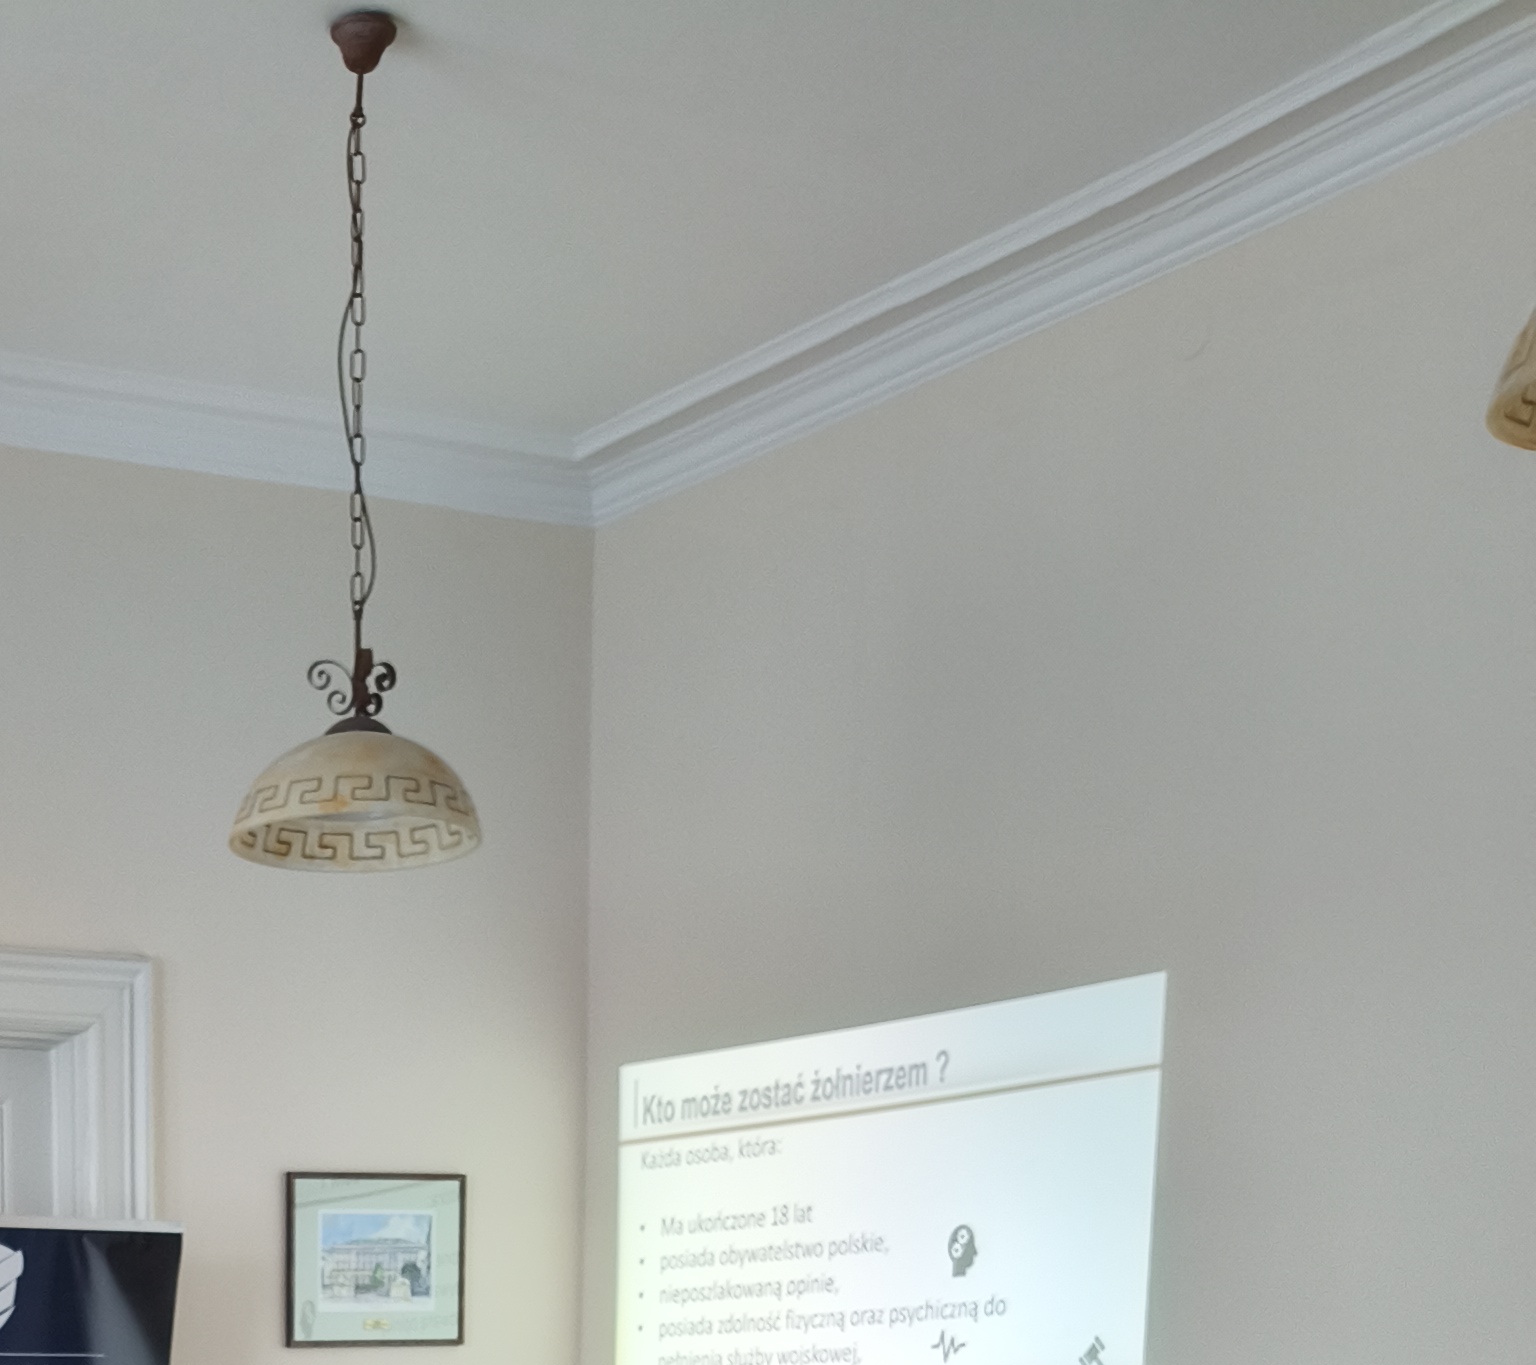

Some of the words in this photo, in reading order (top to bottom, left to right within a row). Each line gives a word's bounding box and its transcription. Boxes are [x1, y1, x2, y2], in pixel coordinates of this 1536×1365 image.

[642, 1094, 675, 1125] Kto
[681, 1085, 732, 1121] może
[738, 1072, 805, 1113] zostać
[810, 1062, 928, 1103] żołnierzem
[935, 1050, 950, 1083] ?
[661, 1217, 684, 1236] Ma
[688, 1210, 766, 1234] ukończone
[771, 1204, 789, 1226] 18
[793, 1203, 814, 1224] lat
[660, 1248, 715, 1273] posiada
[719, 1240, 824, 1267] obywatelstwo
[659, 1316, 713, 1341] posiada
[717, 1311, 782, 1335] zdolność
[786, 1308, 845, 1332] fizyczną
[850, 1308, 884, 1327] oraz
[889, 1299, 979, 1328] psychiczną
[984, 1295, 1007, 1317] do
